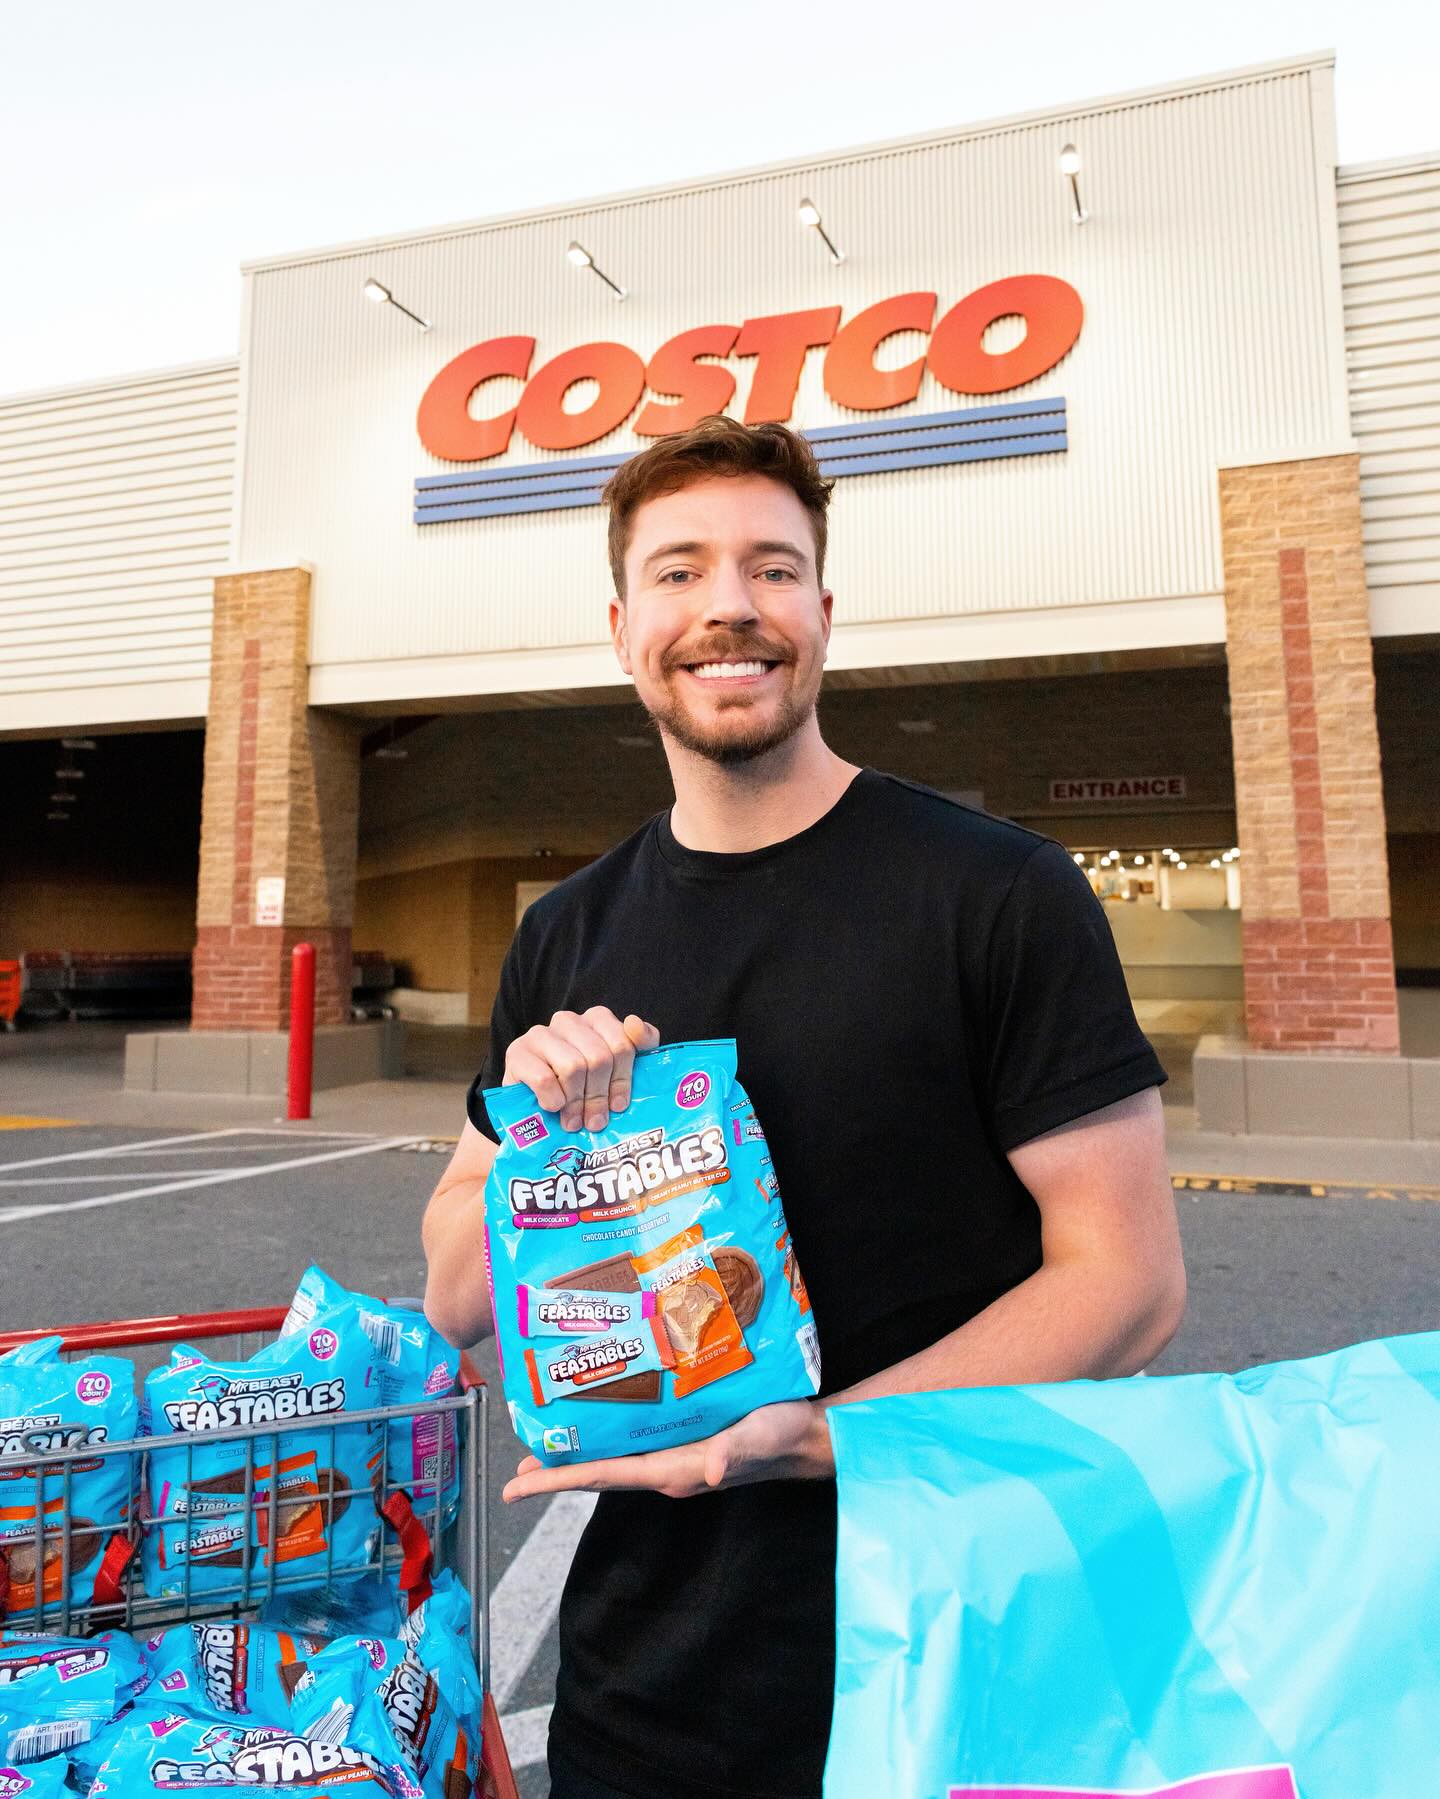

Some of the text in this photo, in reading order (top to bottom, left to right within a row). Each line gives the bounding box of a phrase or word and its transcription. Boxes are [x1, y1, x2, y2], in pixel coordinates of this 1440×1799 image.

[417, 274, 1085, 462] COSTCO
[1054, 779, 1182, 799] ENTRANCE
[682, 1077, 706, 1098] 70
[682, 1090, 706, 1104] COUNT
[516, 1119, 539, 1136] SNACK
[524, 1128, 540, 1142] SIZE
[512, 1130, 725, 1210] FEASTABLES
[650, 1171, 728, 1201] CREAMY PEANUT BUTTER CUP
[592, 1204, 637, 1217] MILK CRUNCH
[582, 1213, 670, 1242] CHOCOLATE CANDY ASSORTMENT
[650, 1257, 705, 1293] FEASTABLES
[539, 1303, 631, 1320] FEASTABLES
[312, 1334, 334, 1349] 70
[315, 1346, 334, 1354] COUNT
[549, 1338, 645, 1381] FEASTABLES
[582, 1366, 617, 1381] MILK CRUNCH
[83, 1378, 106, 1391] 70
[82, 1390, 105, 1398] COUNT
[166, 1379, 345, 1431] FEASTABLES
